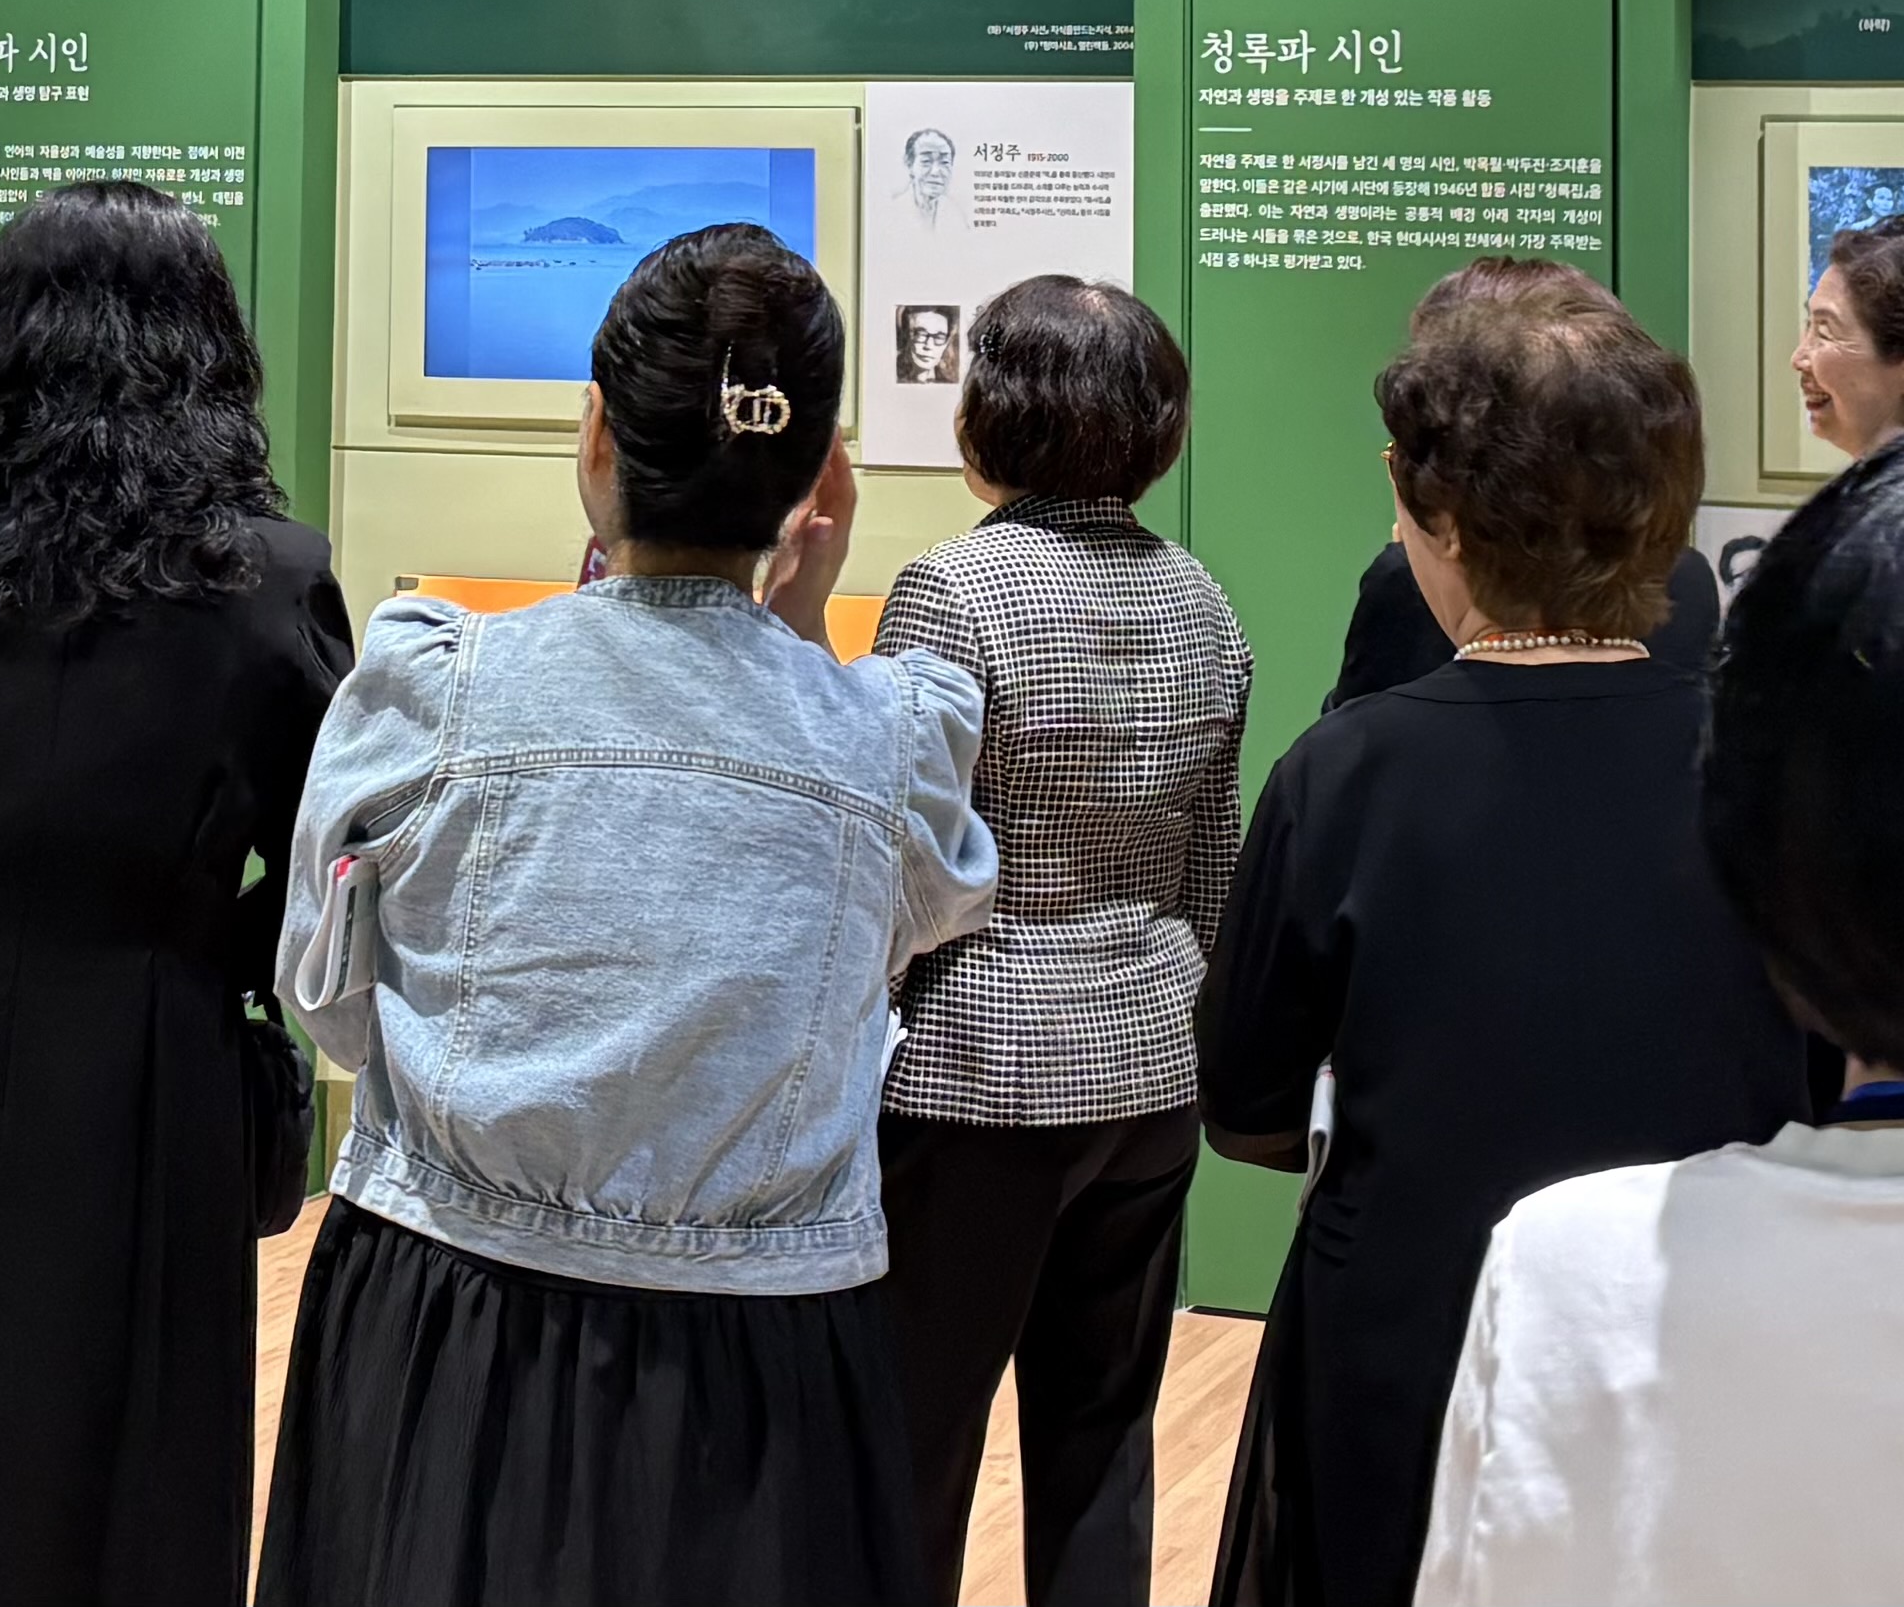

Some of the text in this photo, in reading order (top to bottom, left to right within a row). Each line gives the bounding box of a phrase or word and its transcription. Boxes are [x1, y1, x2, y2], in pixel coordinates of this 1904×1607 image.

[28, 32, 87, 72] 시인
[1201, 29, 1402, 73] 청록파 시인
[973, 143, 1021, 162] 서정주
